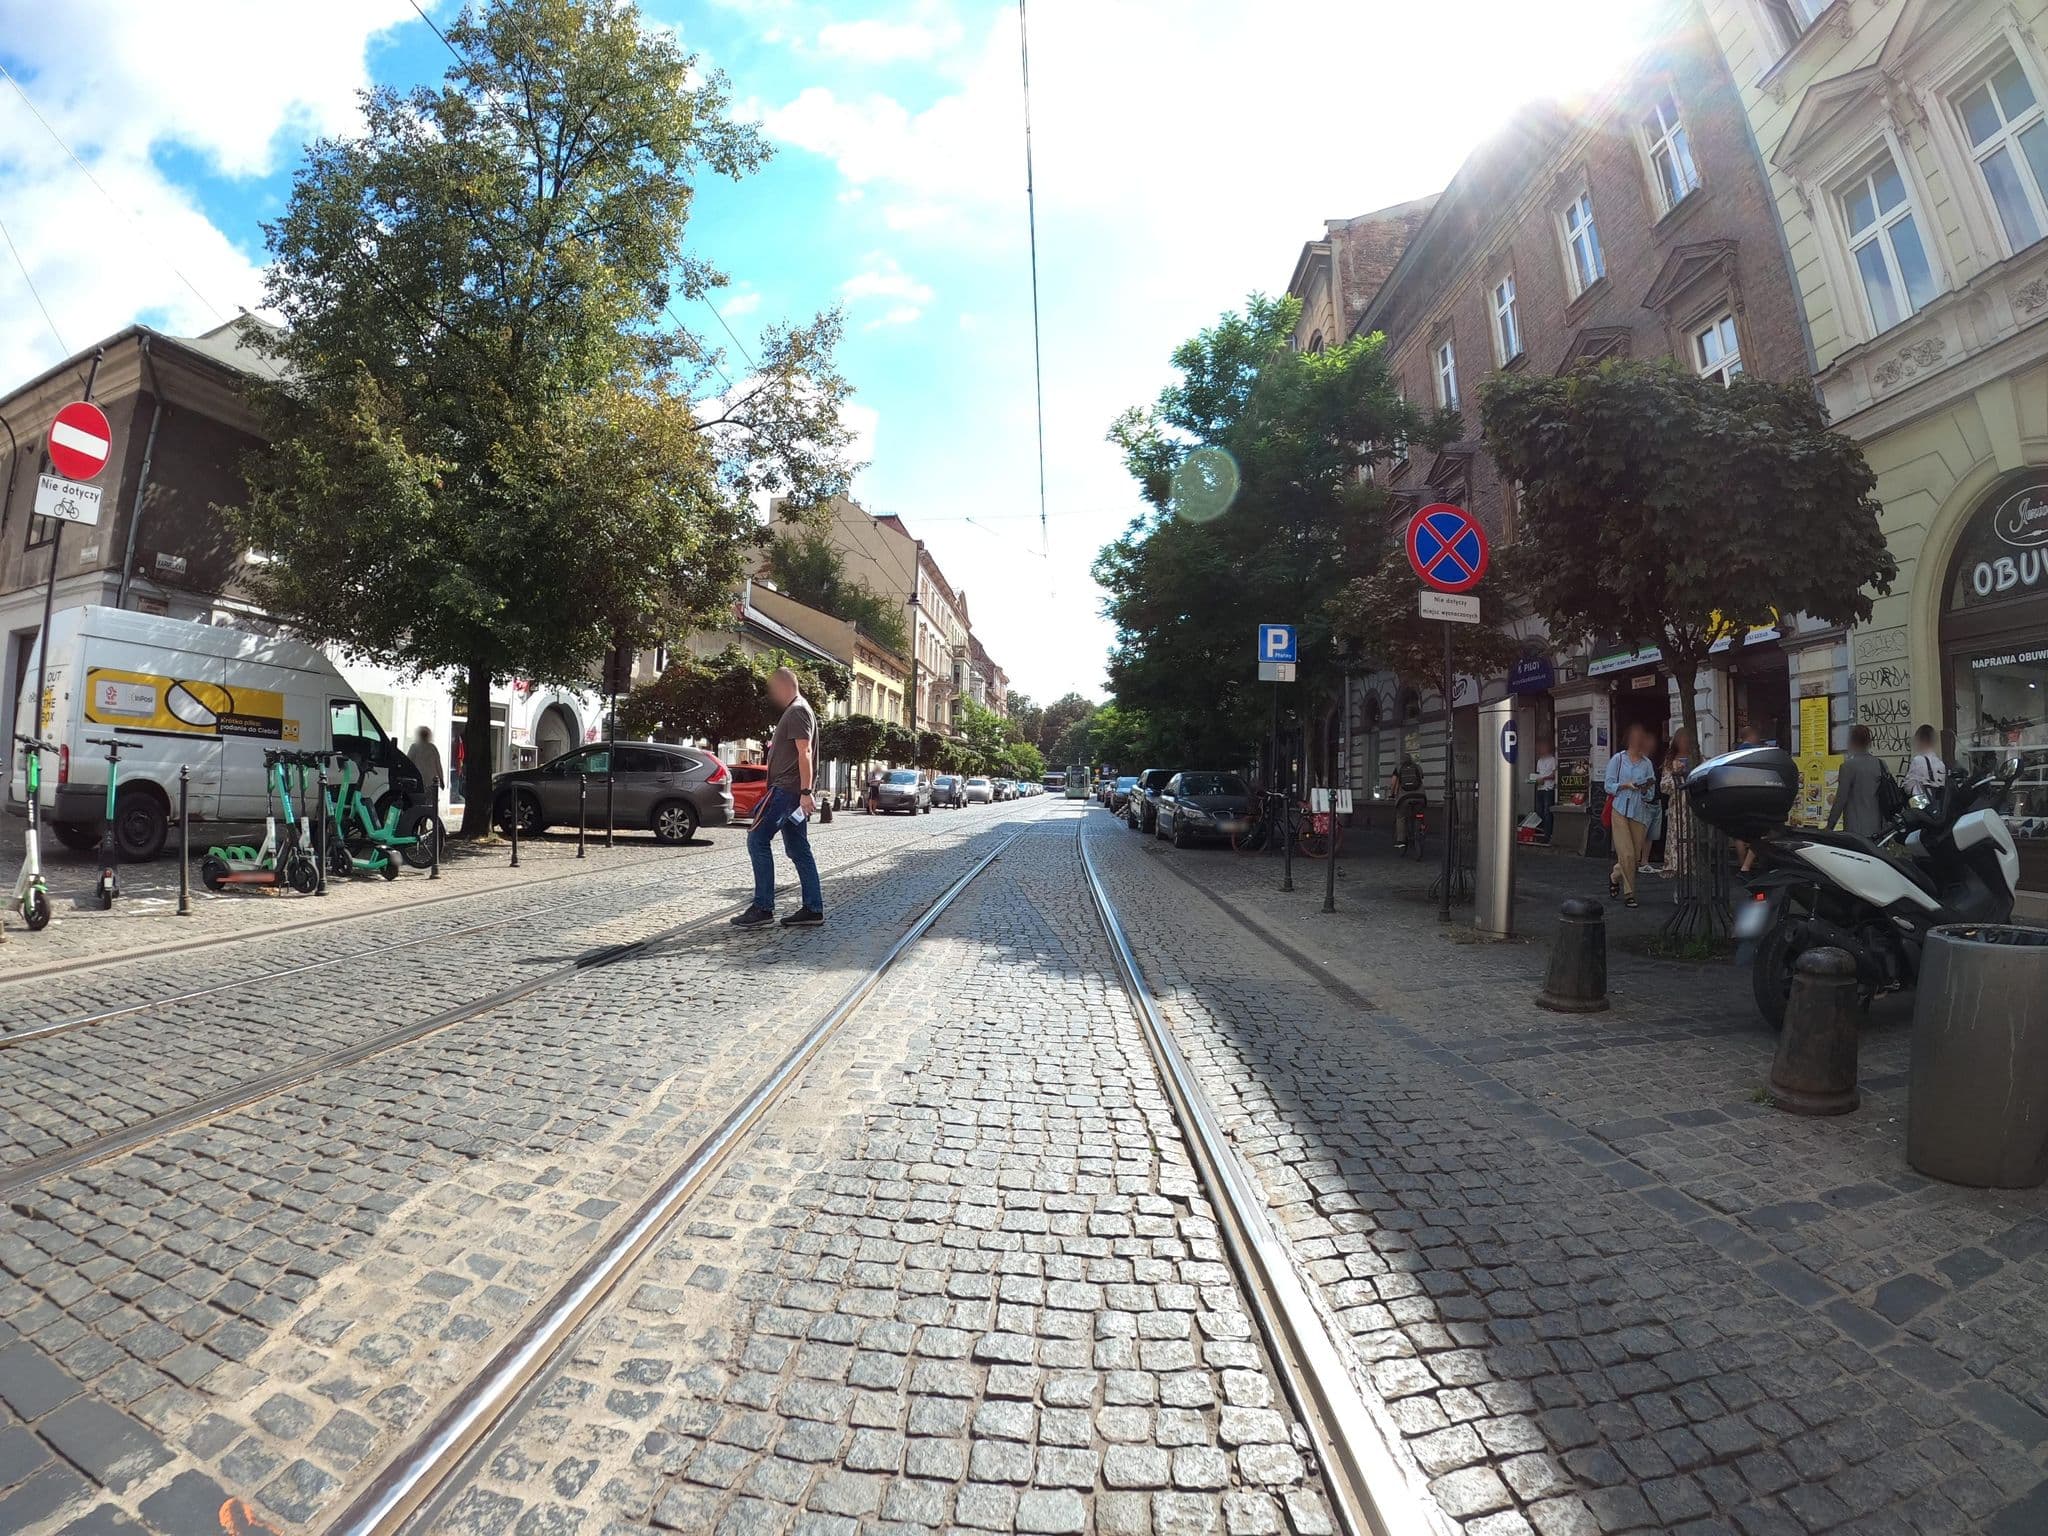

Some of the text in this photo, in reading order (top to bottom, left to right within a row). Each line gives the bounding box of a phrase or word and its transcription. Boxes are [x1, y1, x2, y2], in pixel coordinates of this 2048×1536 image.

[41, 477, 100, 503] Nie dotyczy
[1267, 628, 1289, 658] P
[1972, 654, 2017, 669] NAPRAWA
[46, 670, 62, 683] OUT
[1504, 730, 1518, 753] P
